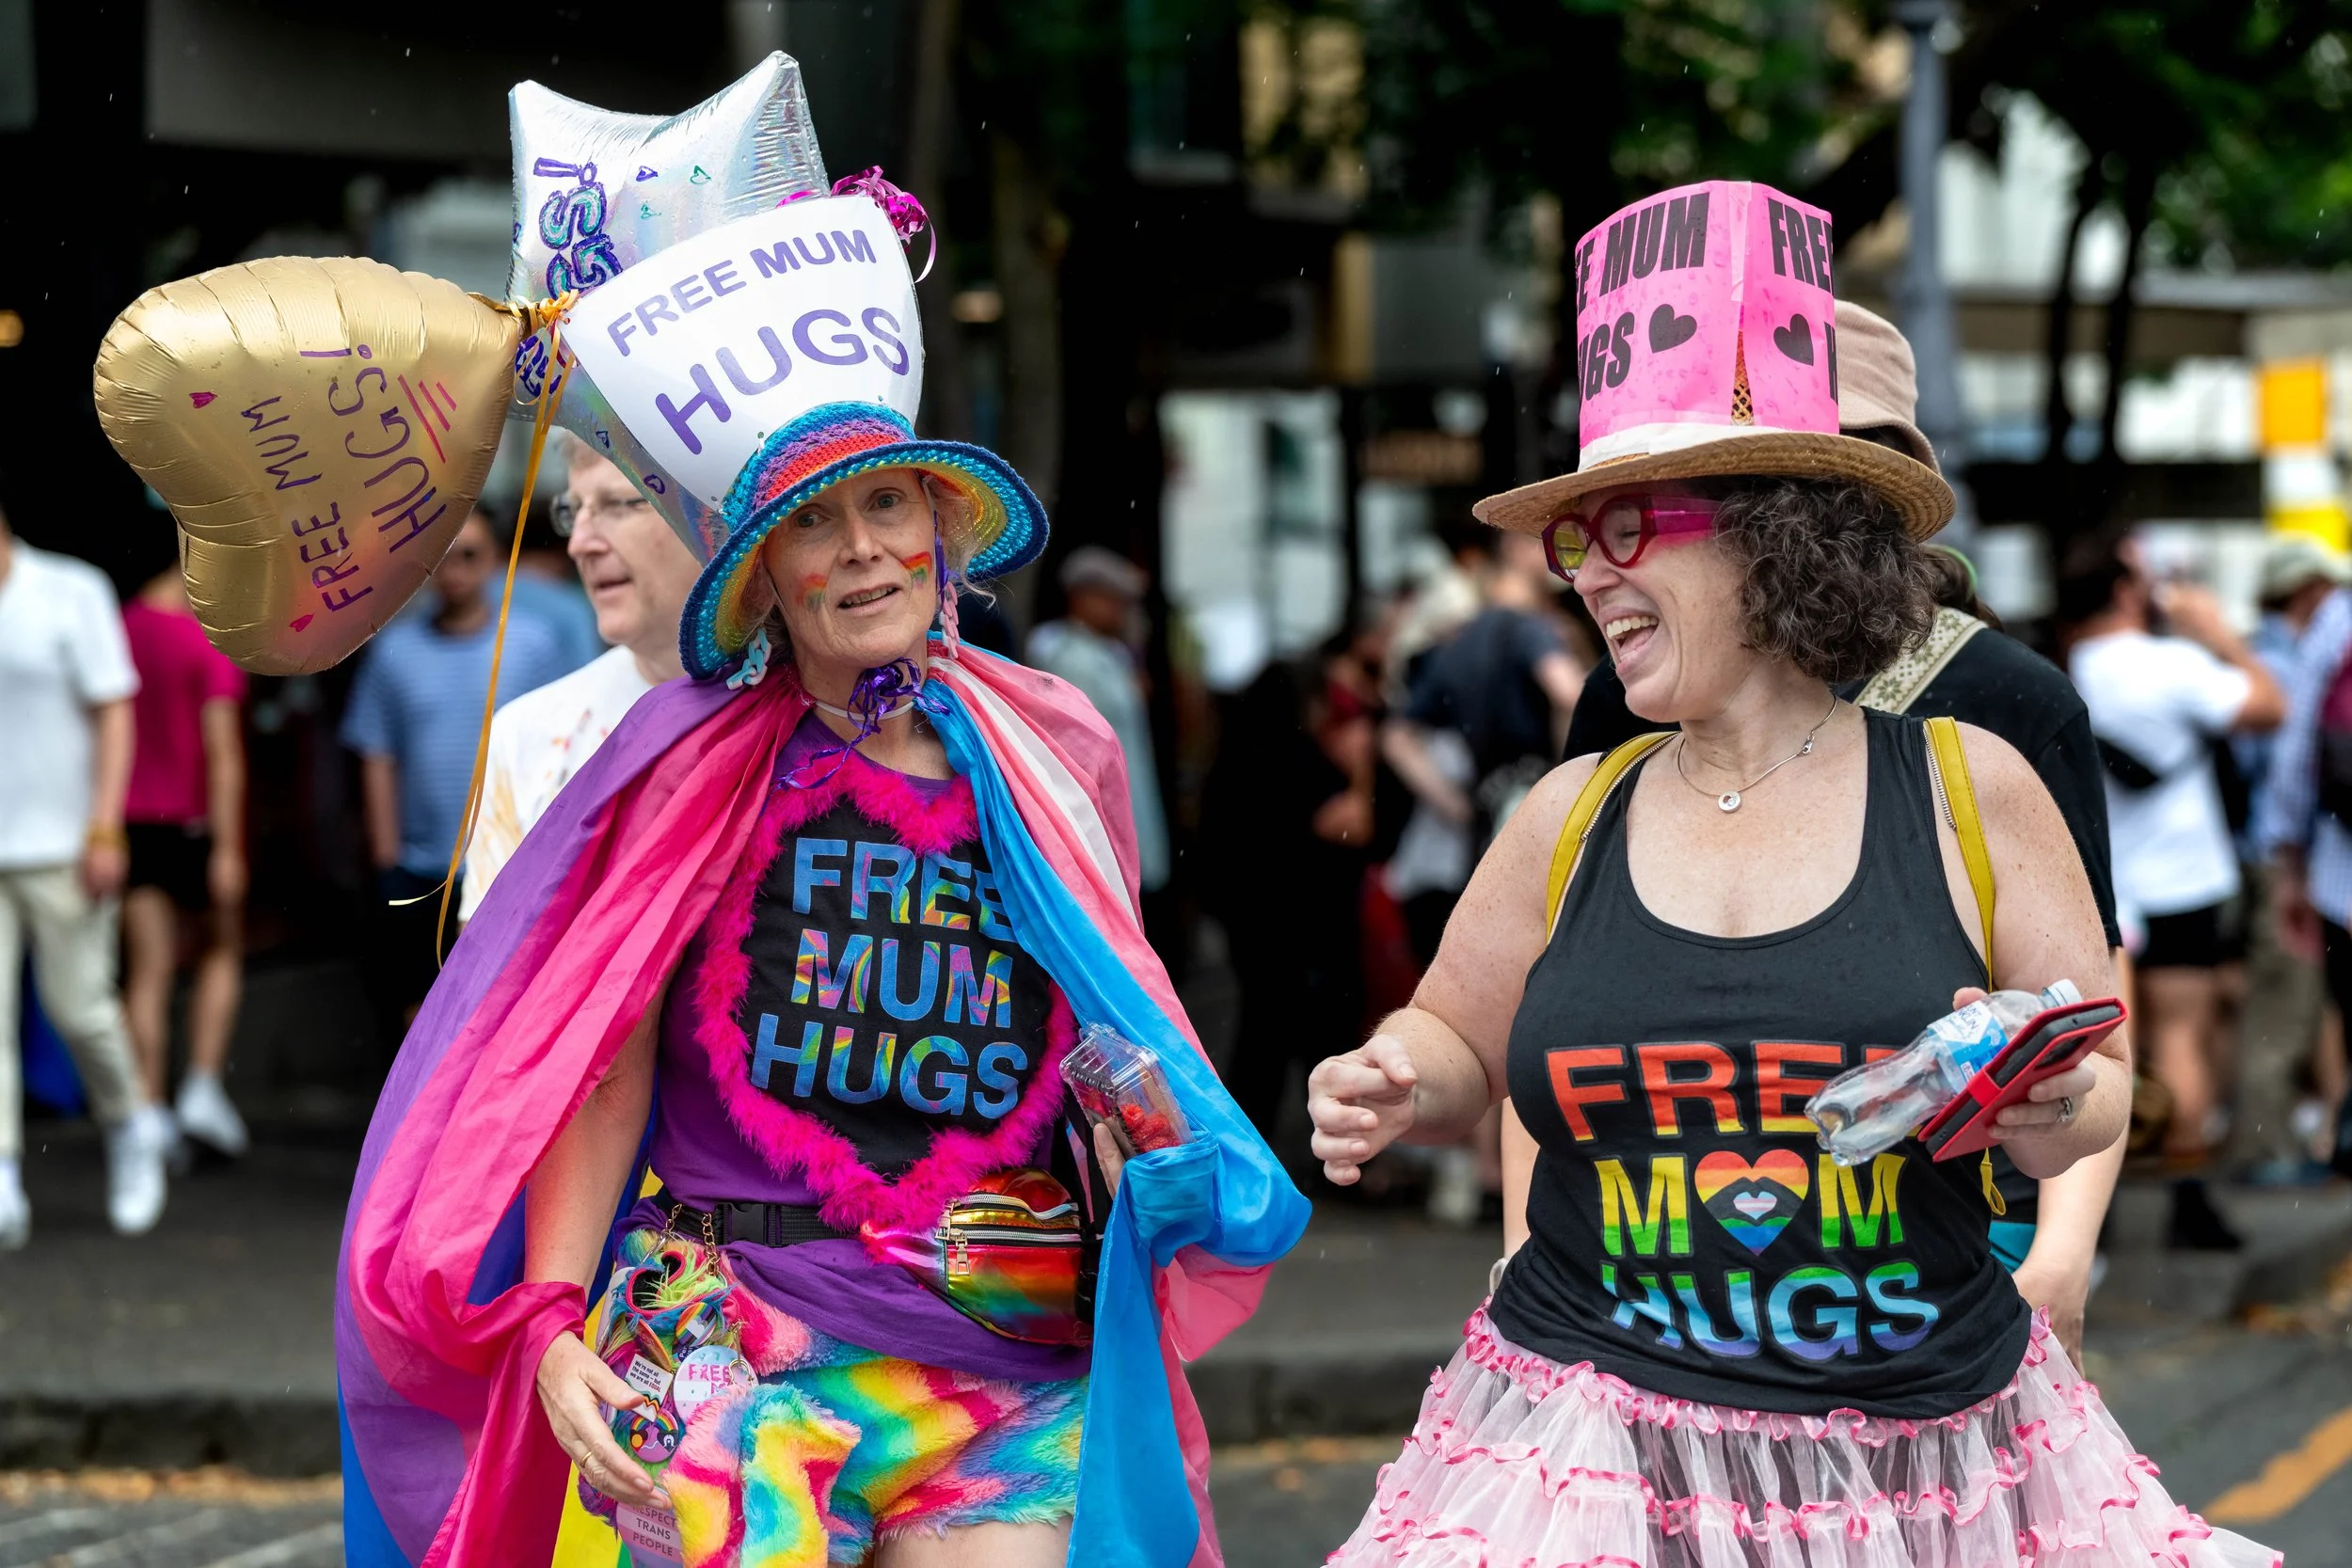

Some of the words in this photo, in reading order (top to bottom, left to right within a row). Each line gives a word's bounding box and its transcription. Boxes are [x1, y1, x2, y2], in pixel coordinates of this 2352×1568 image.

[607, 259, 747, 356] FREE
[750, 229, 878, 279] MUM
[1599, 192, 1710, 297] MUM
[655, 308, 910, 455] HUGS
[241, 396, 323, 490] MUM
[299, 344, 447, 553] HUGS!
[291, 501, 373, 612] FREE
[790, 928, 1013, 1029] MUM
[751, 1013, 1028, 1120] HUGS
[1599, 1260, 1940, 1362] HUGS
[640, 1370, 649, 1379] same
[633, 1531, 673, 1557] PEOPLE
[636, 1517, 671, 1540] TRANS
